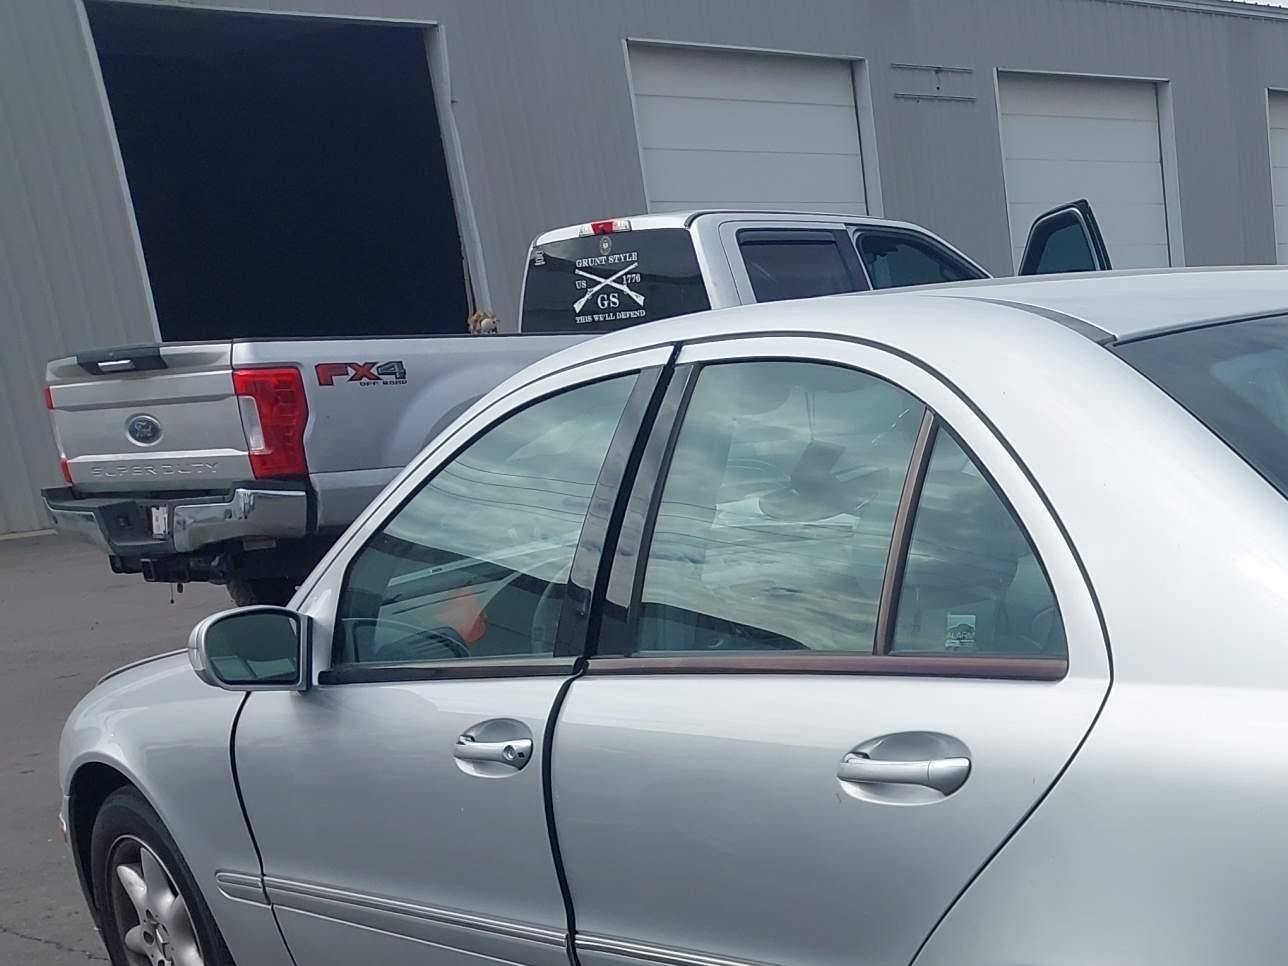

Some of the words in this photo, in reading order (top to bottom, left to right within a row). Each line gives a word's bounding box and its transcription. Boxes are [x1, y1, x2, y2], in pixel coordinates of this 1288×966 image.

[576, 256, 606, 268] GRUNT
[608, 252, 638, 264] STYLE
[575, 280, 587, 289] US
[597, 293, 619, 308] GS
[617, 310, 645, 319] DEFEND
[314, 360, 407, 387] FX4
